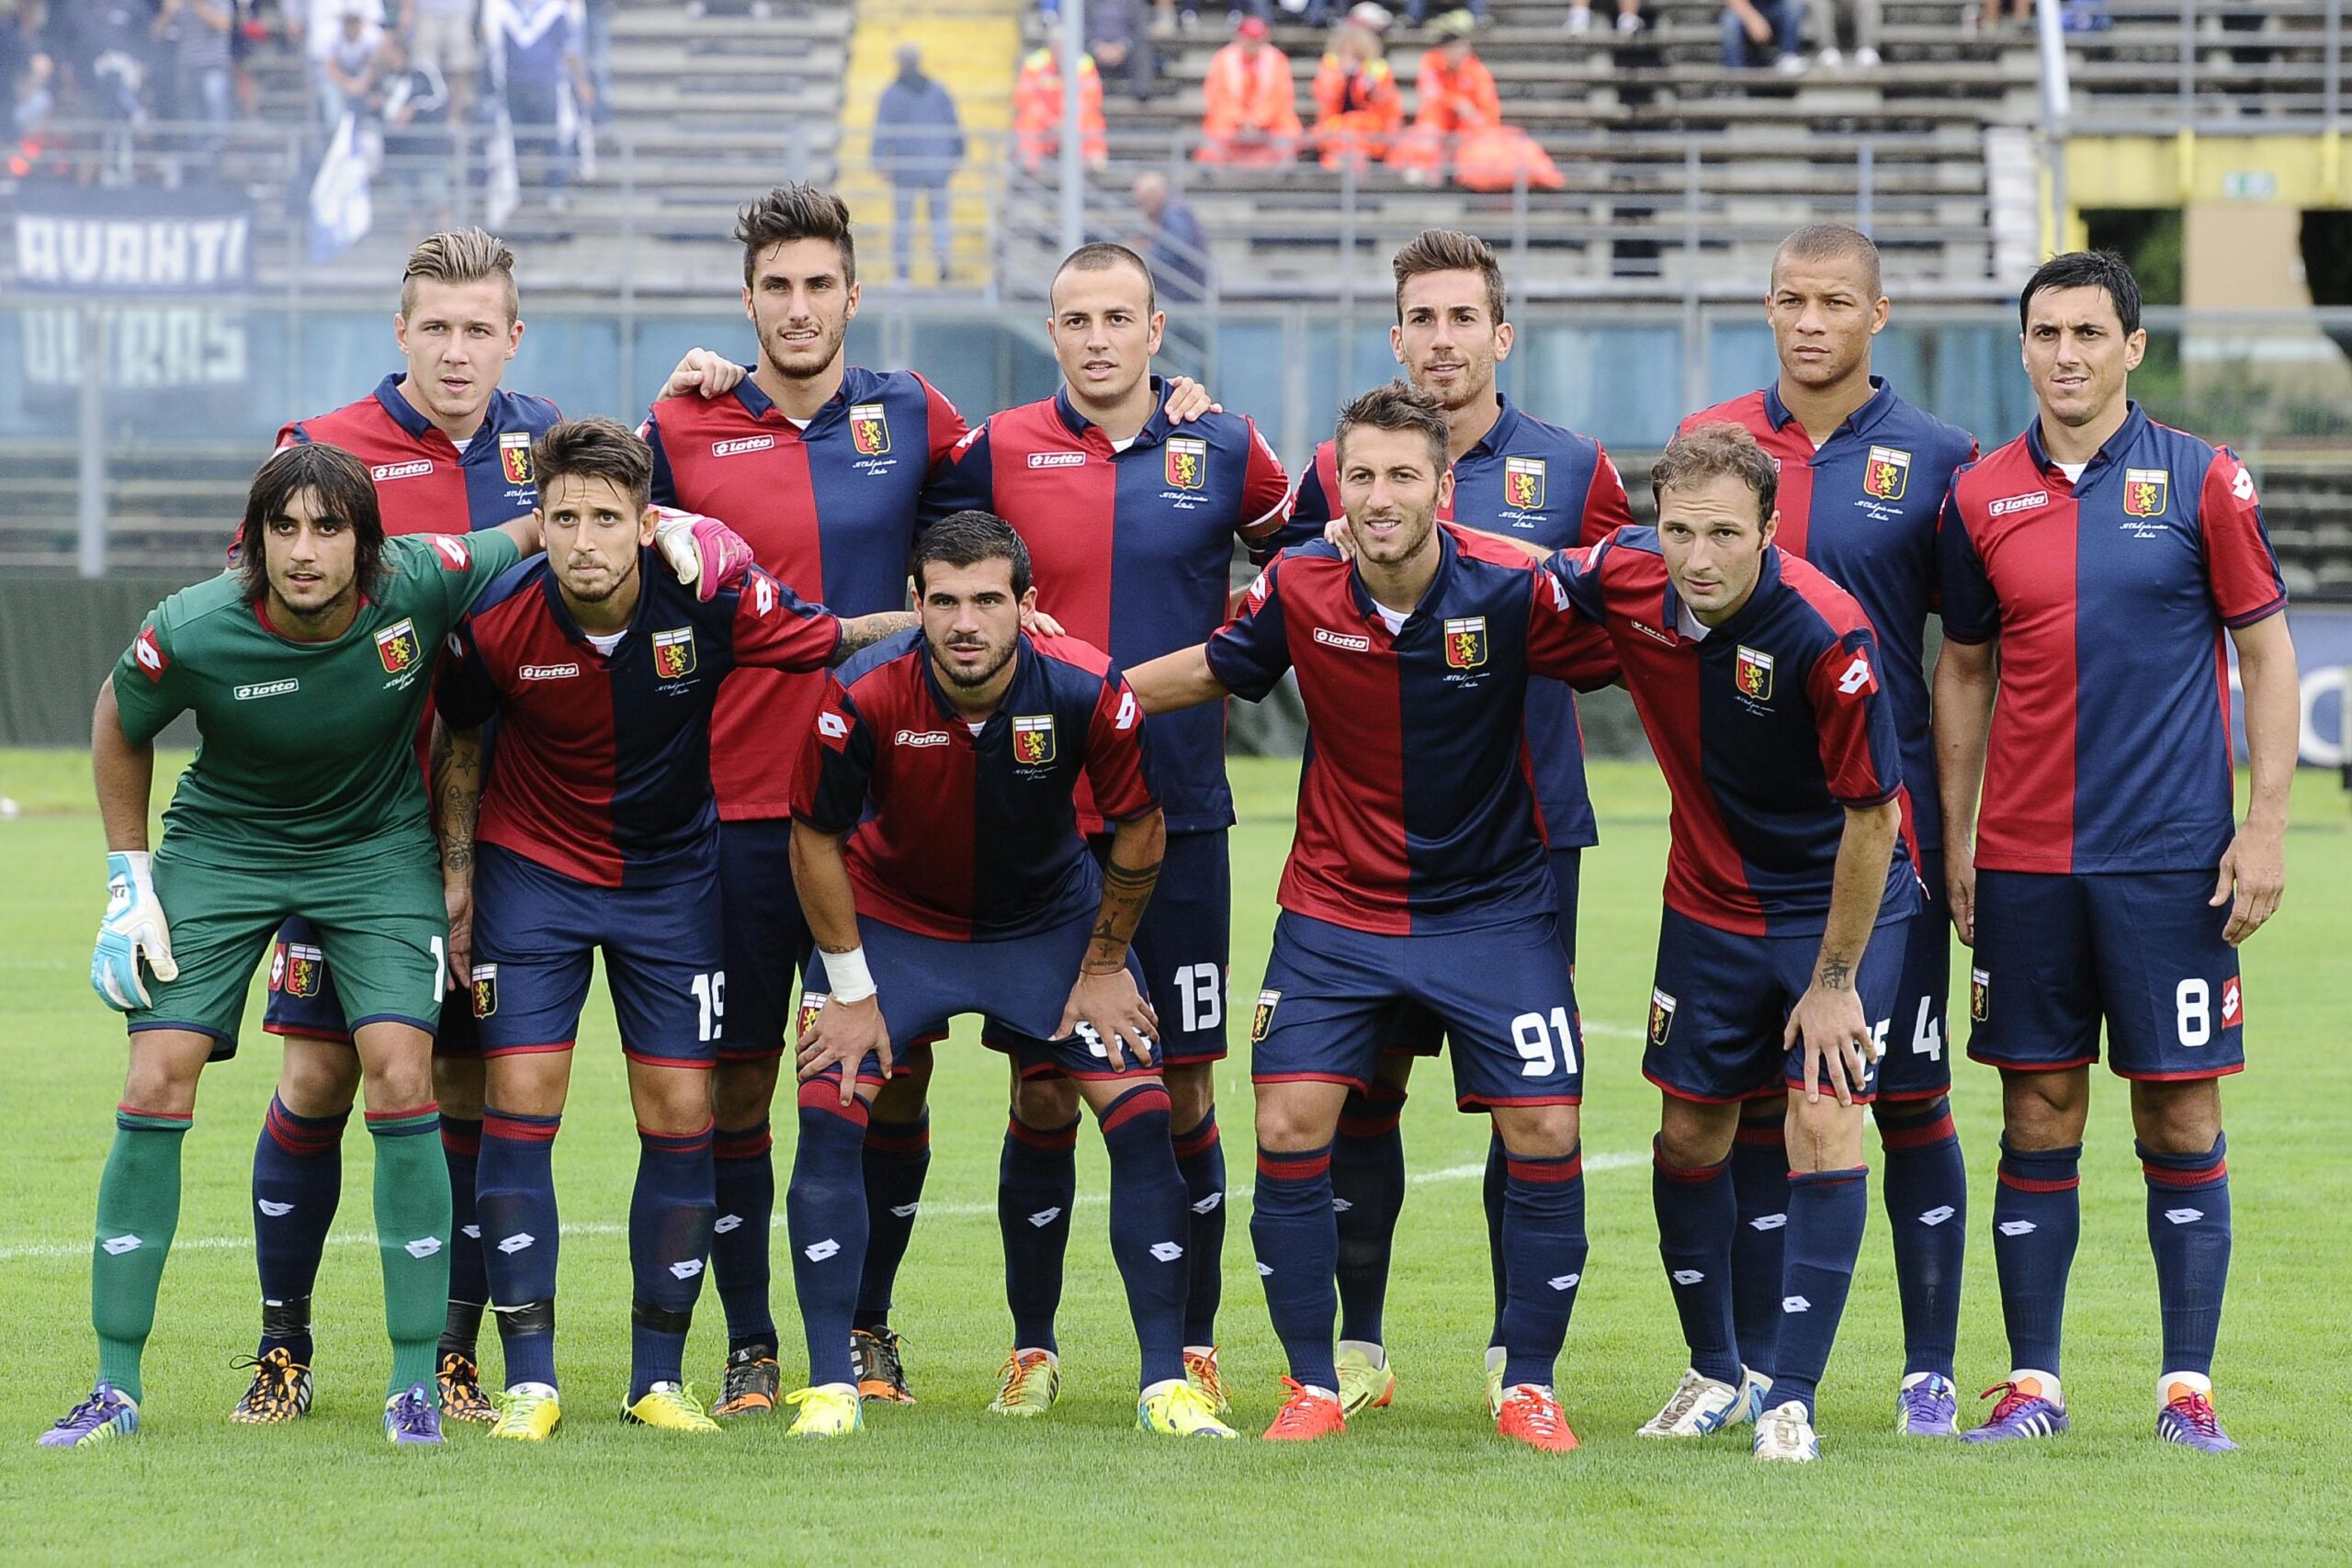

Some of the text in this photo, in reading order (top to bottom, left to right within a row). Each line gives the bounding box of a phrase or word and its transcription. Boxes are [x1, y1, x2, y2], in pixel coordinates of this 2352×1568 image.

[429, 935, 445, 1003] 1
[1173, 963, 1221, 1032] 13
[1510, 1007, 1578, 1077] 91
[1912, 996, 1941, 1062] 4
[2177, 978, 2210, 1047] 8
